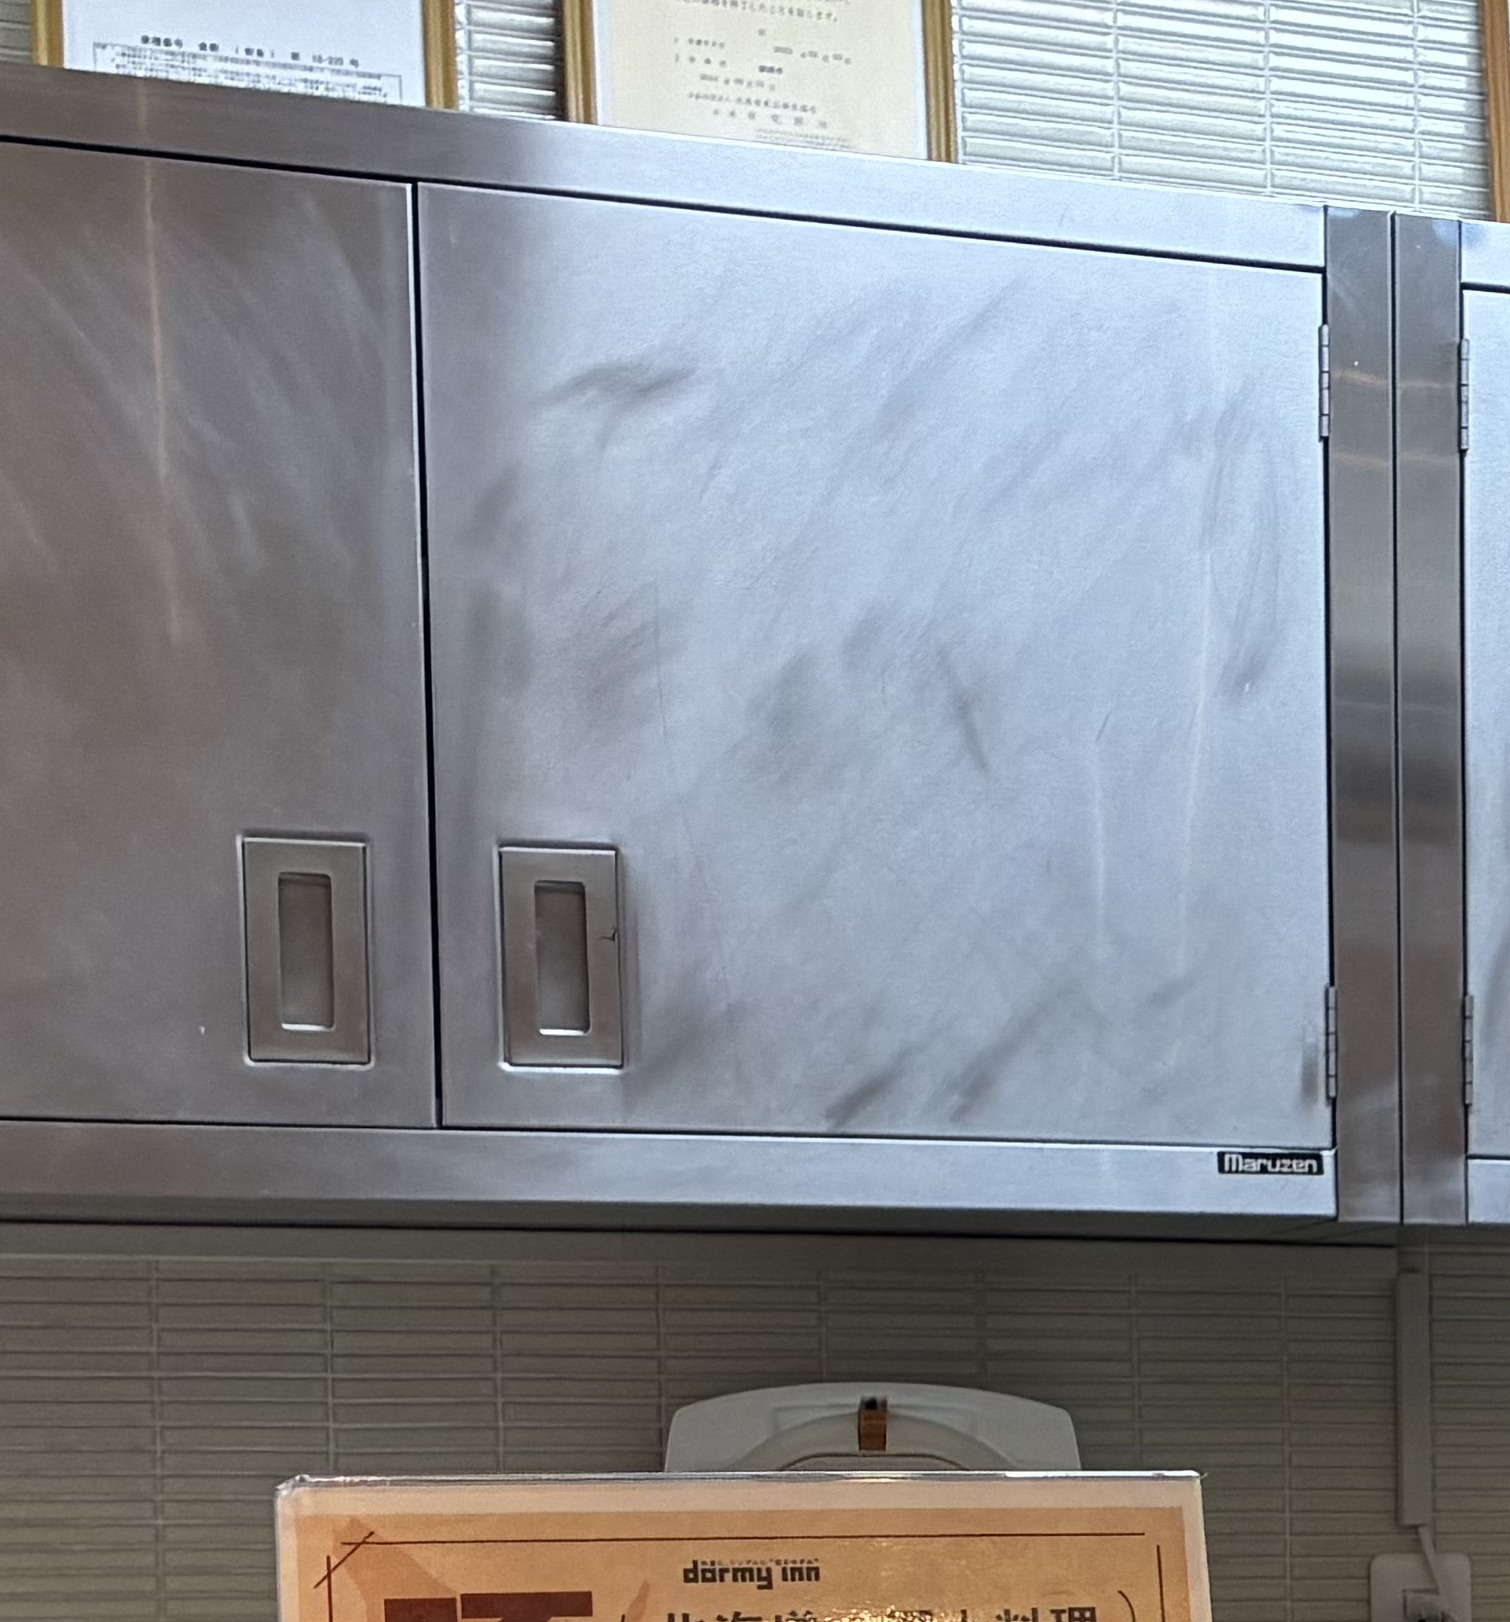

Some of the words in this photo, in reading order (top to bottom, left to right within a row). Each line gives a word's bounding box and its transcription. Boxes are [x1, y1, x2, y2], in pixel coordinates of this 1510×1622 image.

[1224, 1153, 1318, 1173] Maruzen
[683, 1560, 773, 1590] dormy
[781, 1566, 820, 1582] inn
